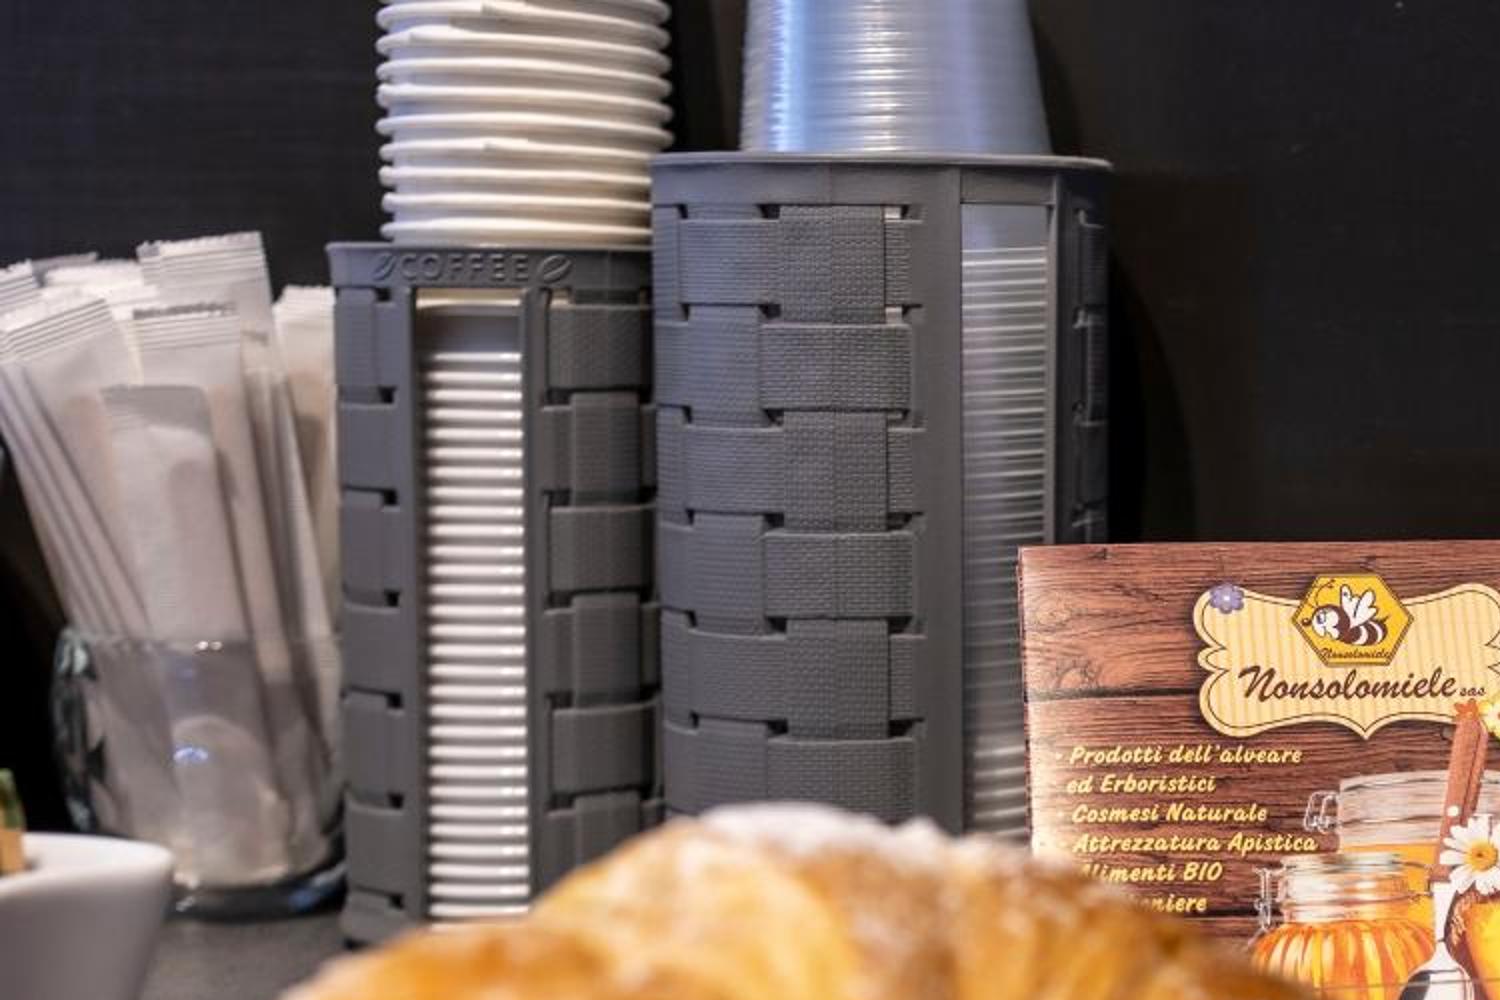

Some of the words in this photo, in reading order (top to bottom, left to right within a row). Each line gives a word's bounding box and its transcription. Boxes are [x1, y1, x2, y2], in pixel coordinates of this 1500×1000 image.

[401, 253, 530, 282] COFFEE
[1238, 665, 1458, 702] Nonsolomiele
[1459, 686, 1486, 697] sas
[1069, 745, 1163, 764] Prodotti
[1168, 745, 1303, 764] dell'alveare
[1067, 775, 1093, 794] ed
[1100, 773, 1217, 793] Erboristici
[1072, 803, 1159, 824] Cosmesi
[1165, 803, 1268, 823] Naturale
[1073, 832, 1222, 853] Attrezzatura
[1227, 831, 1319, 857] Apistica
[1183, 862, 1223, 882] BIO
